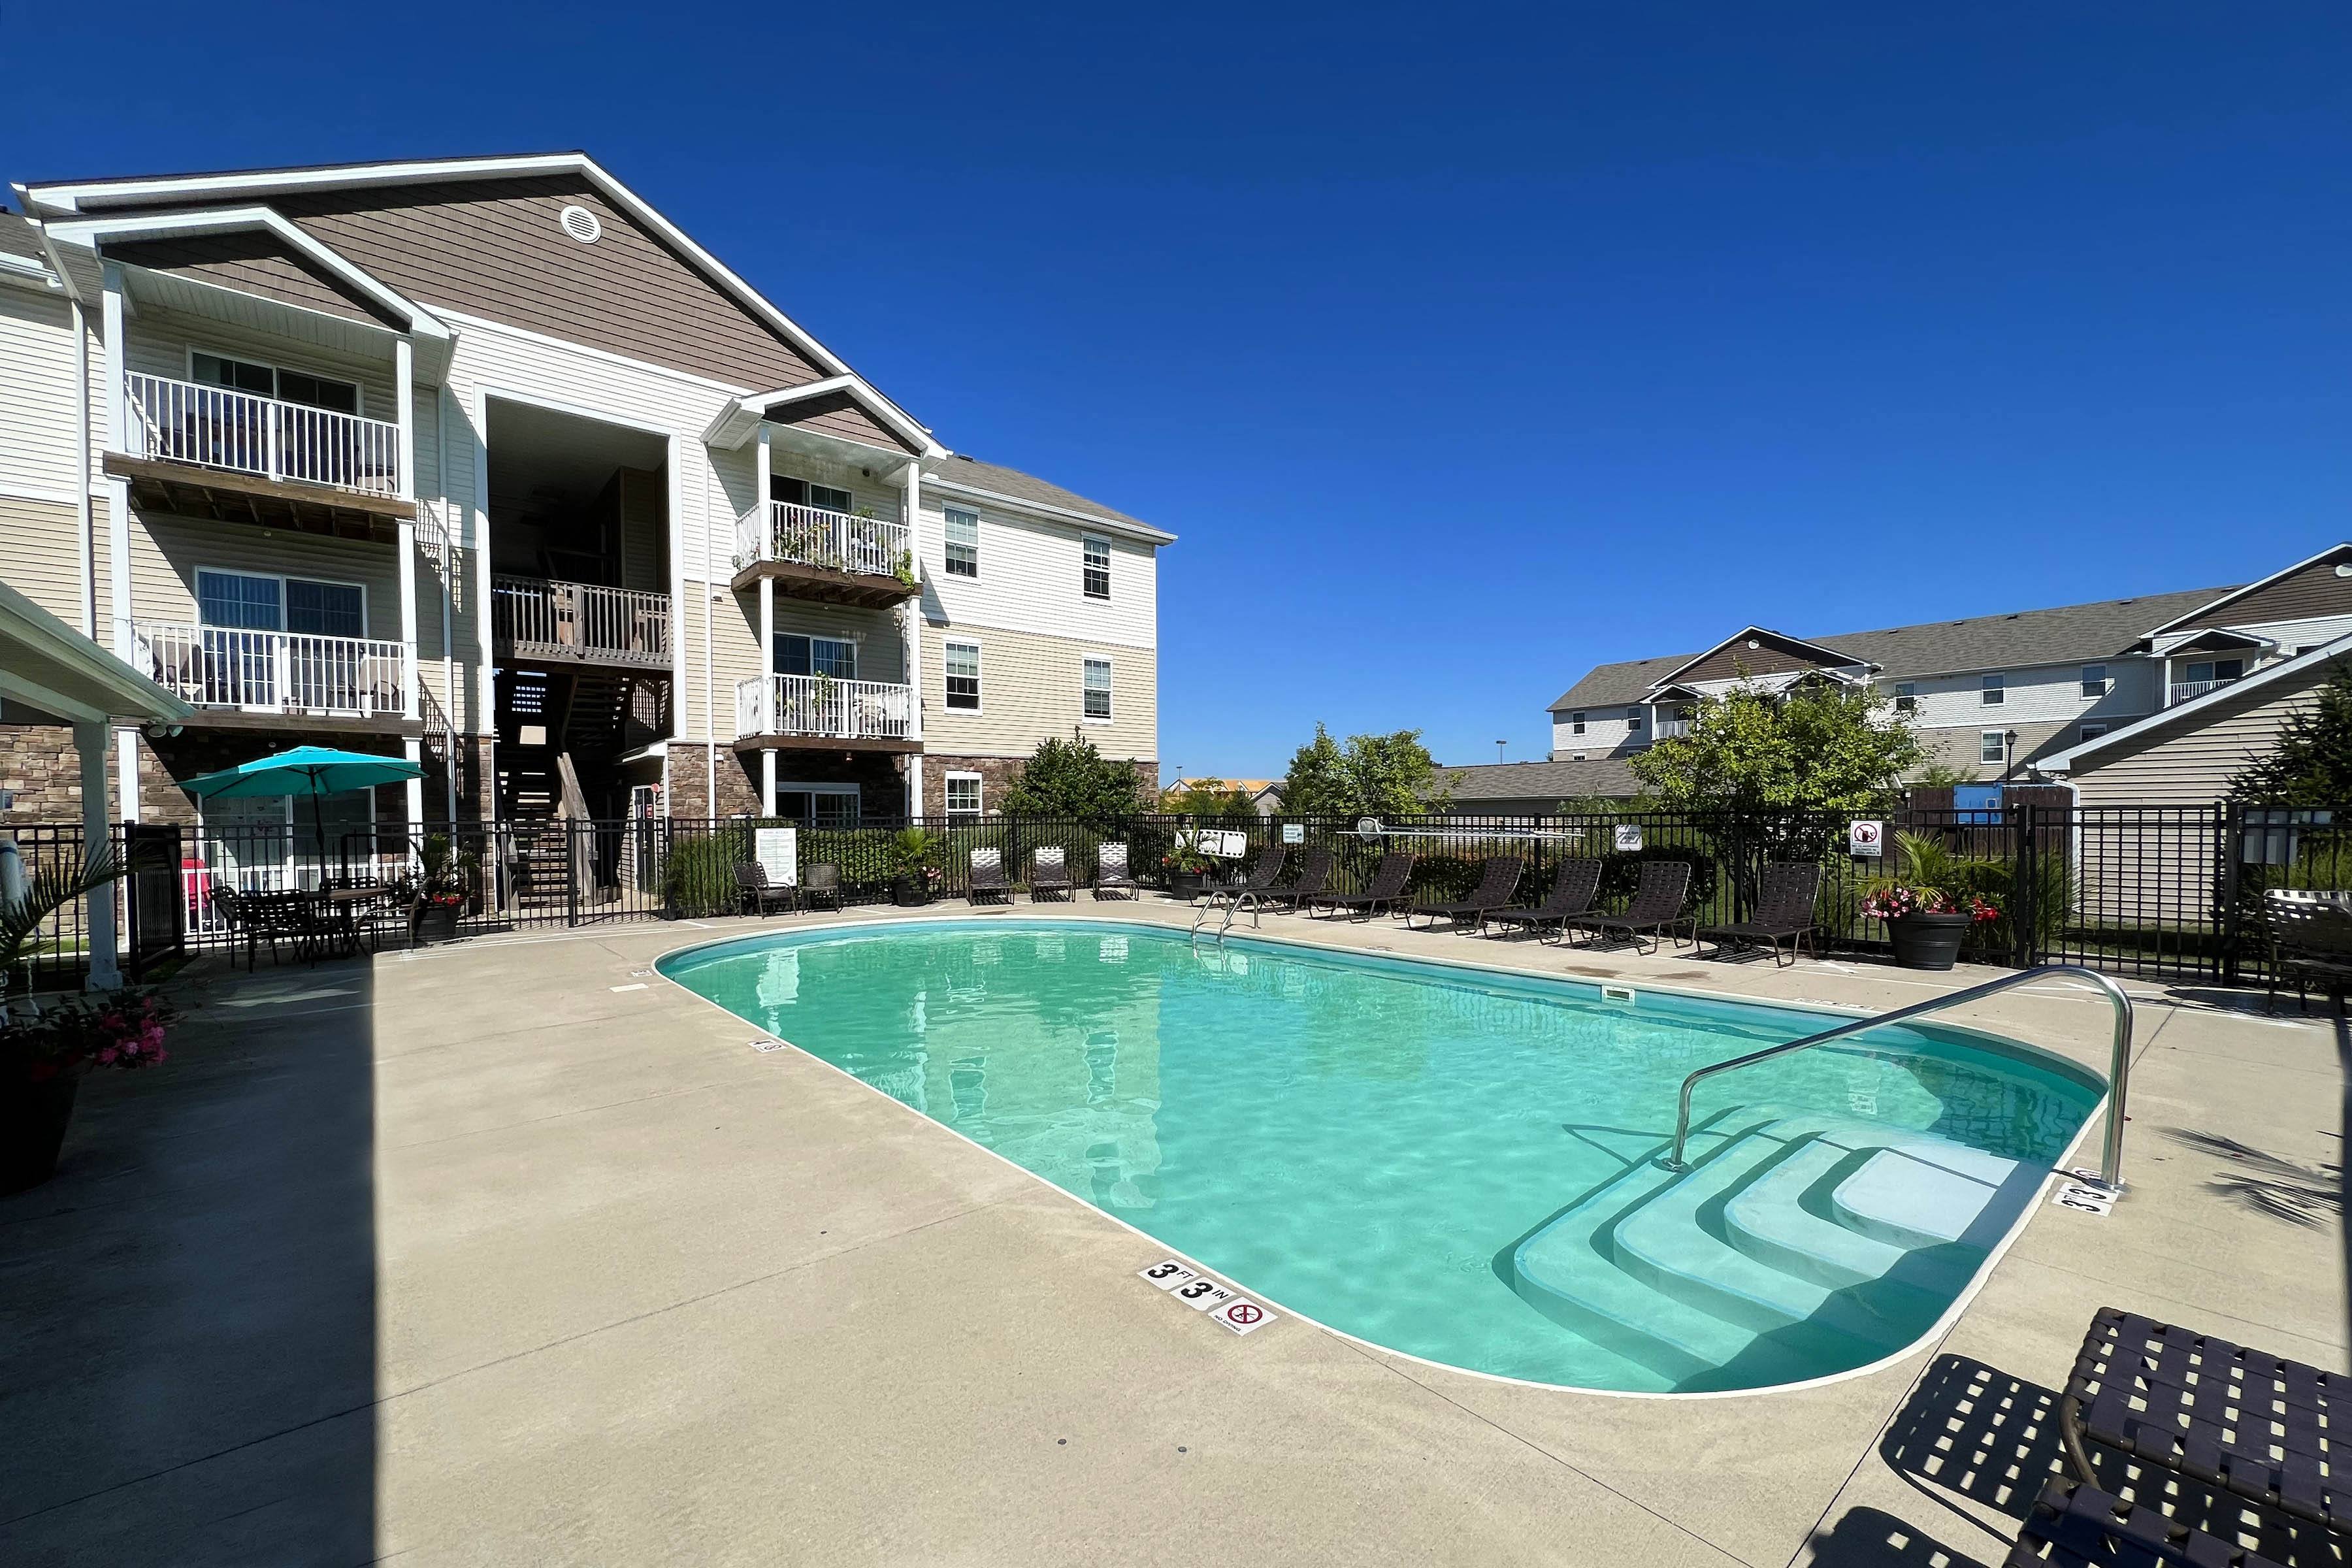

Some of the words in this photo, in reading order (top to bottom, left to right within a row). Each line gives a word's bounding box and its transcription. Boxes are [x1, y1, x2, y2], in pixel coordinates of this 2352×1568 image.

[2068, 1188, 2107, 1200] 3
[2061, 1200, 2100, 1212] 3
[1147, 1264, 1179, 1279] 3
[1181, 1282, 1214, 1299] 3
[1211, 1289, 1229, 1299] IN
[1222, 1320, 1241, 1331] DIVING
